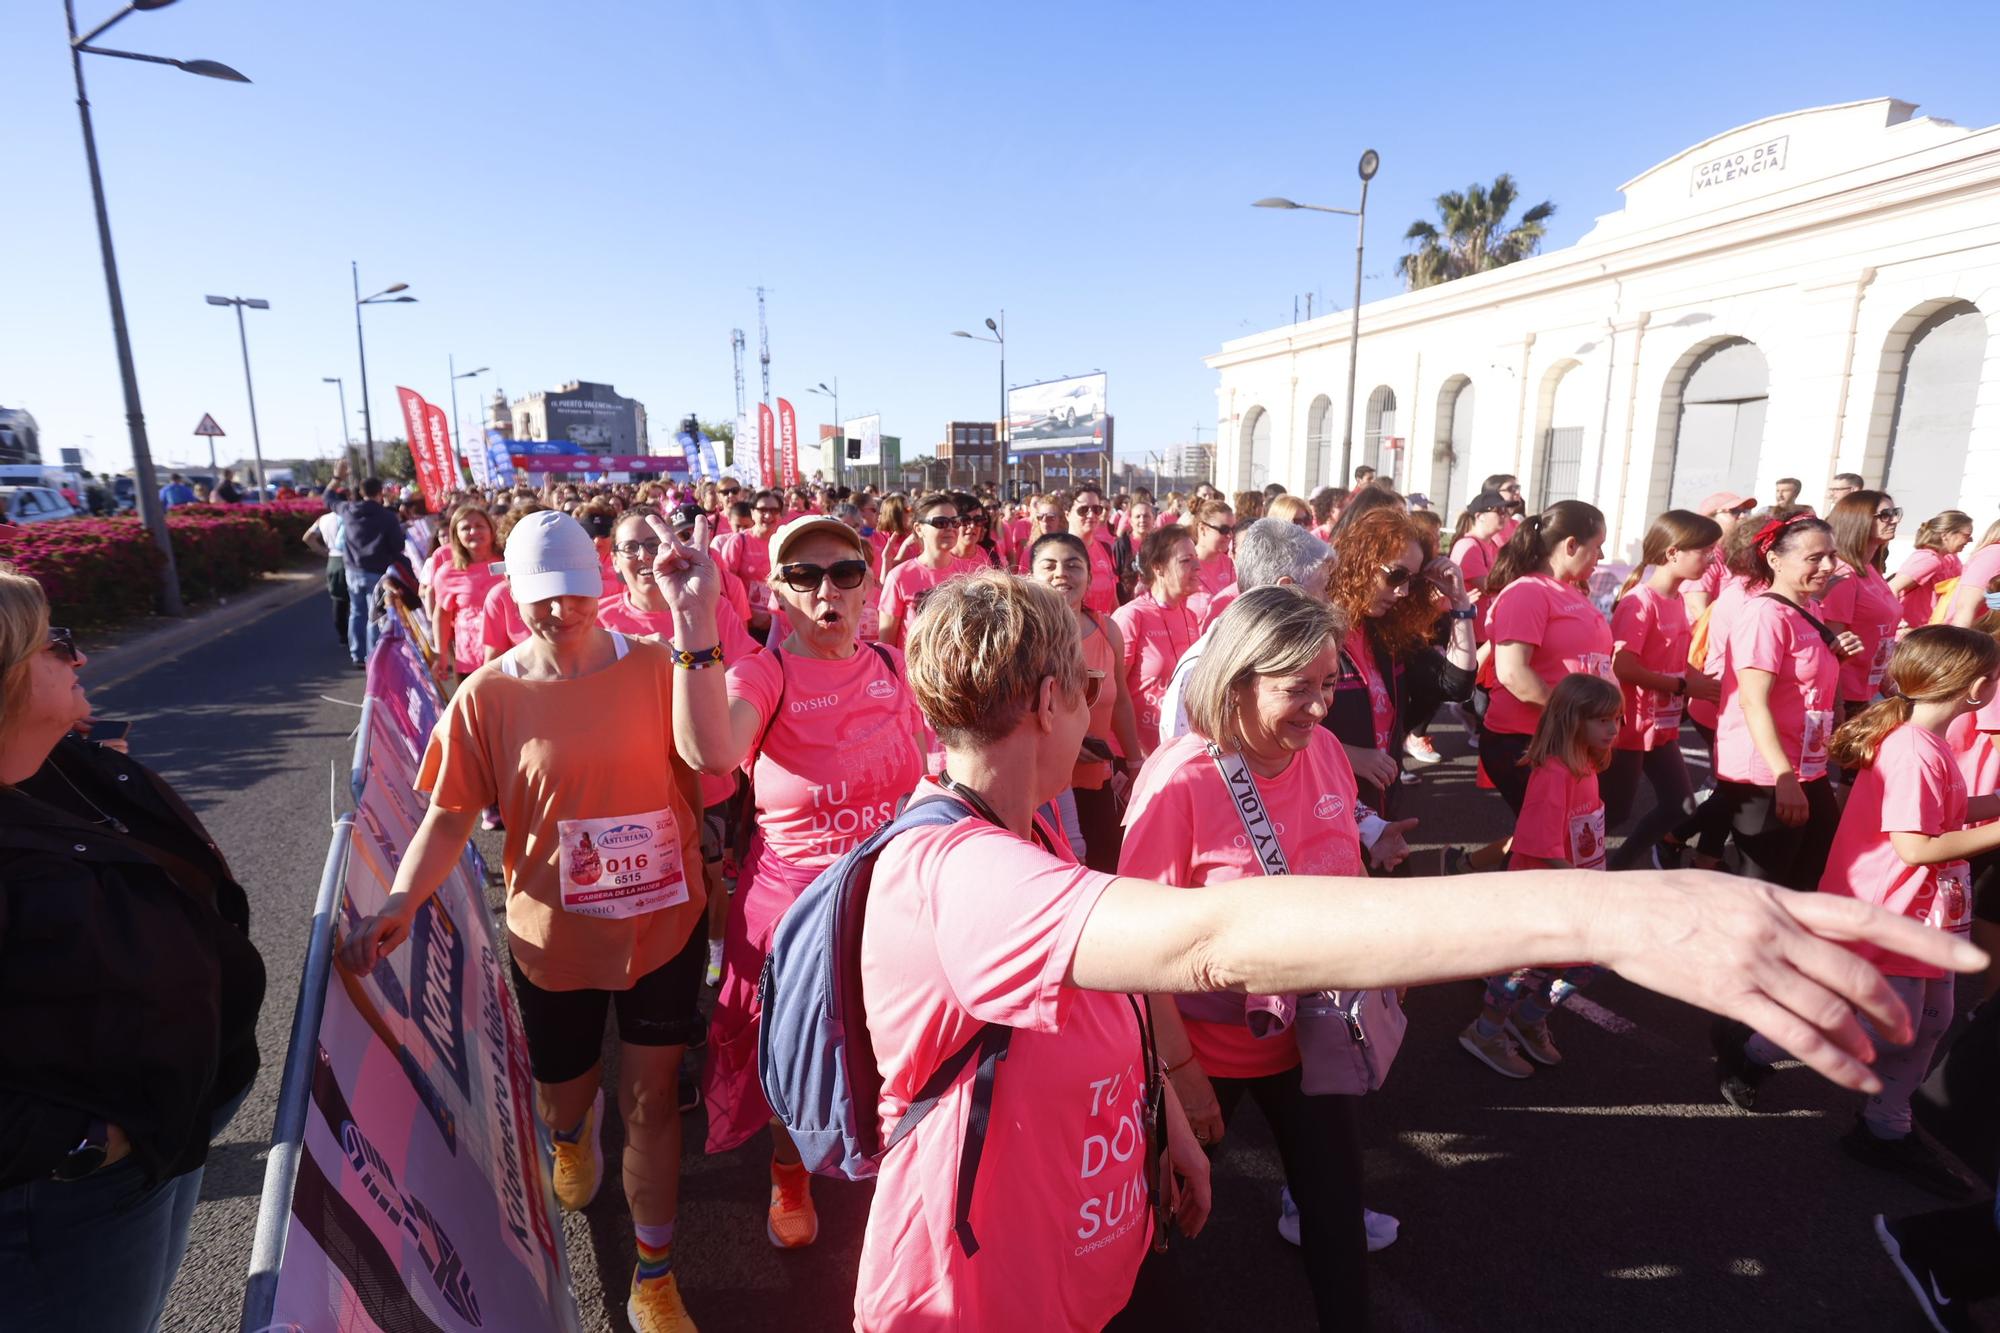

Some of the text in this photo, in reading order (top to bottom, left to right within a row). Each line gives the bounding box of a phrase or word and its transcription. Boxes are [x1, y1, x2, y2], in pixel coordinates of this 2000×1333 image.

[1696, 157, 1779, 190] VALENCIA
[1701, 143, 1778, 176] GRAO DE
[782, 409, 796, 486] Santander
[791, 694, 839, 713] OYSHO
[808, 780, 847, 808] TU
[1230, 767, 1265, 826] LOLA
[811, 802, 892, 834] DORS
[601, 833, 649, 846] ASTURIANA
[1255, 834, 1272, 849] Y
[606, 854, 648, 873] 016
[614, 872, 641, 885] 6515
[578, 882, 660, 902] CARRERA DE LA MUJER
[422, 905, 457, 1070] Noraut
[1090, 1066, 1132, 1117] TU
[1077, 1169, 1148, 1239] SUM
[1075, 1232, 1115, 1257] CARRERA
